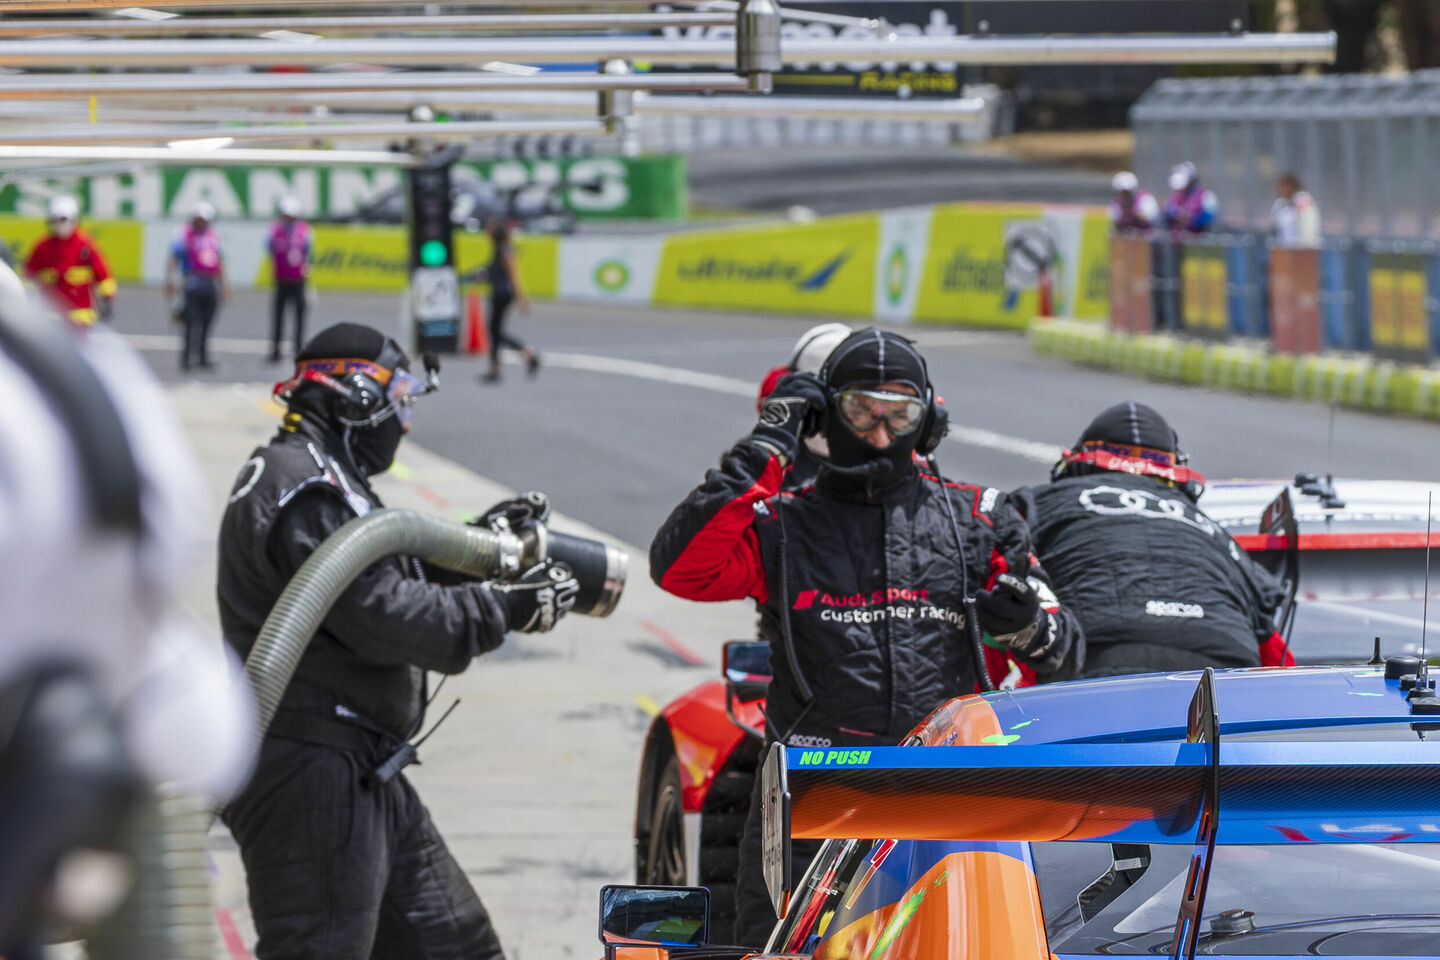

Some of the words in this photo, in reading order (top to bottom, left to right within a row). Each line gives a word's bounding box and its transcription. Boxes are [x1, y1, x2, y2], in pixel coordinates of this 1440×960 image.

[820, 592, 868, 608] Audi
[870, 588, 929, 606] Sport
[820, 605, 915, 625] customer
[920, 605, 966, 630] racing
[800, 751, 823, 765] NO
[825, 750, 872, 764] PUSH
